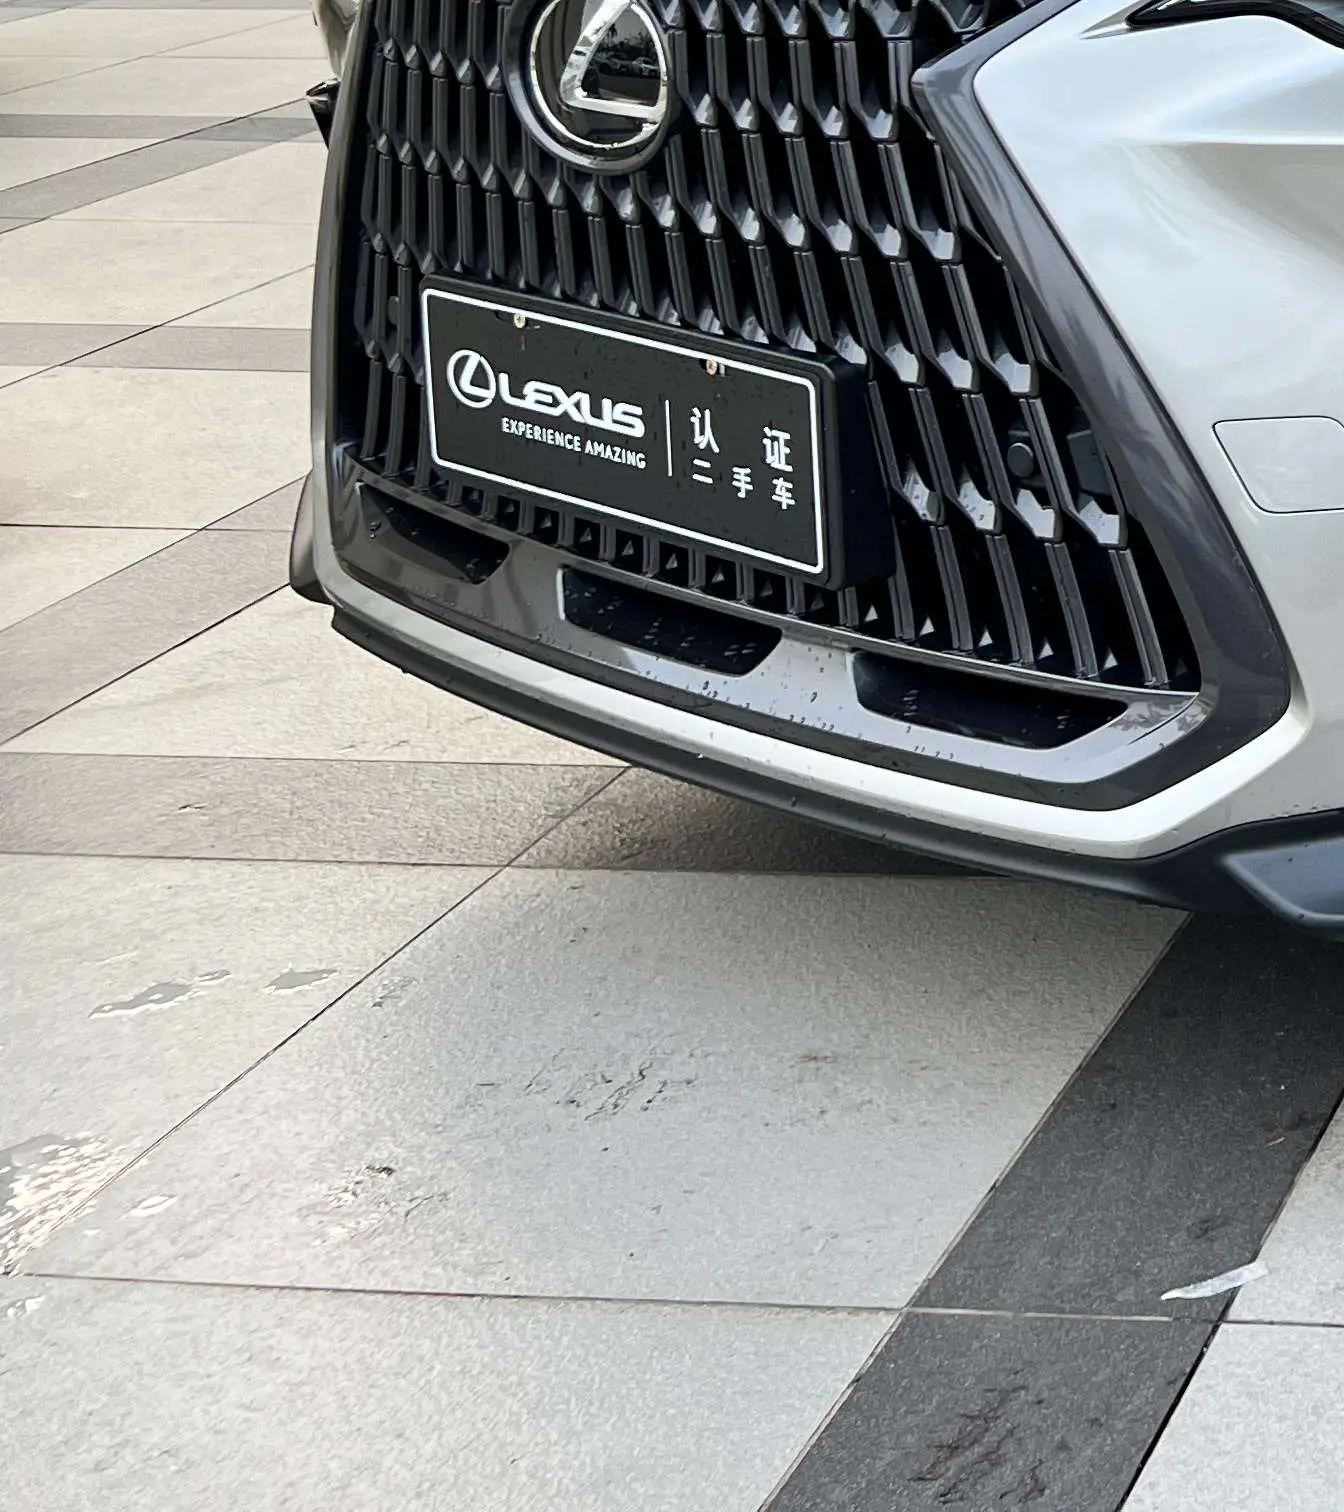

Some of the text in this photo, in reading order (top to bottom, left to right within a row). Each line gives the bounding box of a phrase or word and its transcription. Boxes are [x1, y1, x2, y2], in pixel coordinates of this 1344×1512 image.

[498, 370, 793, 473] LEXUS 认证
[501, 416, 647, 471] EXPERIENCE AMAZING
[691, 458, 795, 511] 二手车
